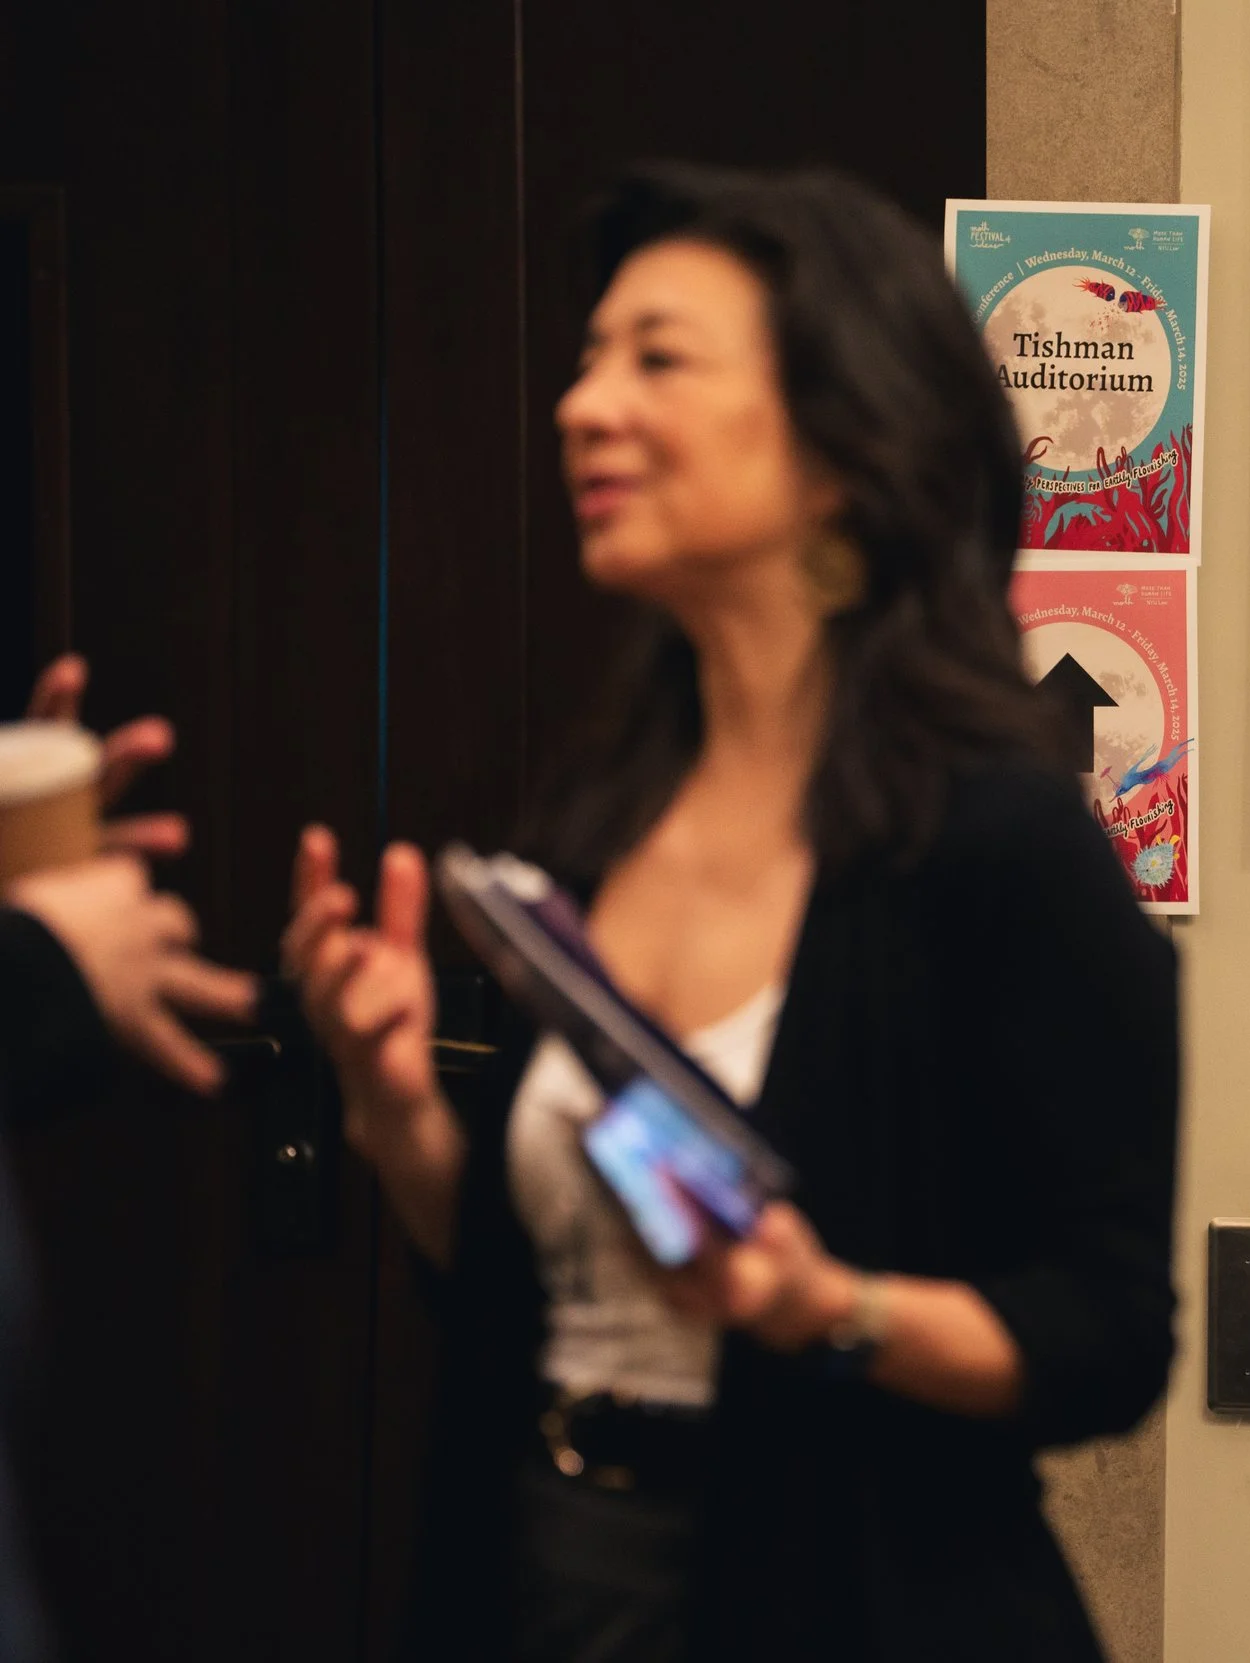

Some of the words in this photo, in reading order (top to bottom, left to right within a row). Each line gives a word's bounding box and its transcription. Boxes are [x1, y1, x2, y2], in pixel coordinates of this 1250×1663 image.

[1025, 248, 1089, 269] Wednesday,
[1091, 250, 1125, 270] March
[1125, 265, 1137, 277] 12
[1165, 309, 1187, 345] March
[1177, 364, 1187, 391] 2025
[1013, 331, 1135, 360] Tishman
[998, 362, 1154, 393] Auditorium
[1036, 478, 1085, 492] PERSPECTIVES
[1088, 483, 1100, 492] FOR
[1018, 604, 1080, 625] Wednesday,
[1081, 606, 1115, 625] March
[1115, 620, 1126, 632] 12
[1131, 630, 1159, 664] Friday,
[1157, 661, 1178, 697] March
[1171, 716, 1180, 741] 2025
